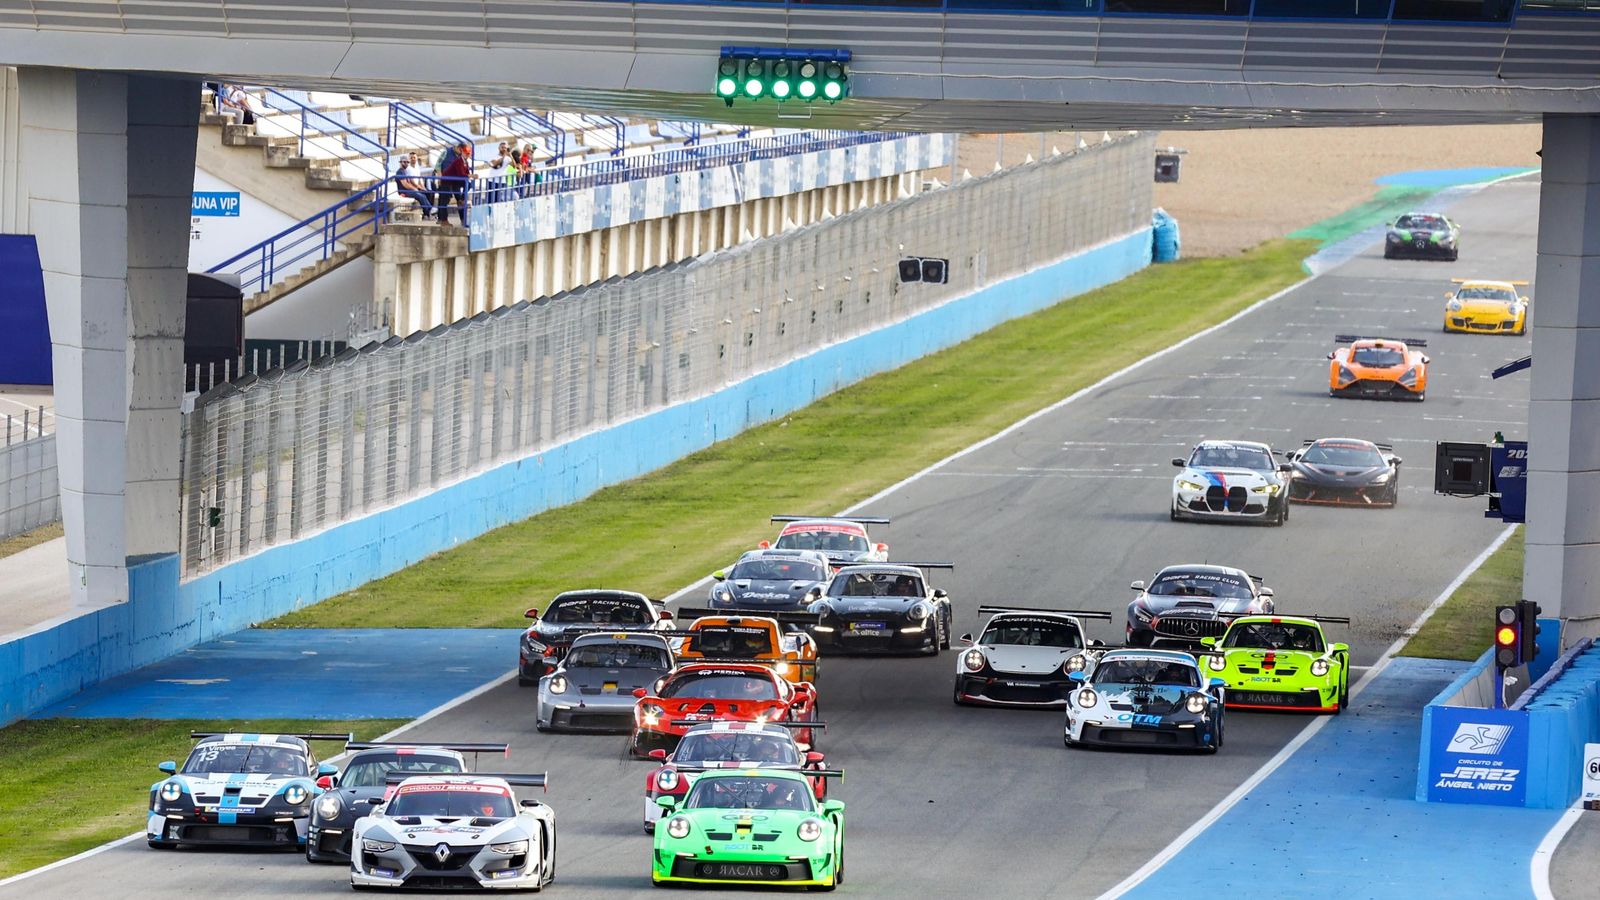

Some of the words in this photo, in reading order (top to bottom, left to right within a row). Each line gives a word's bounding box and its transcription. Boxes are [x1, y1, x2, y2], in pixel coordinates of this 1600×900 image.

[220, 197, 237, 209] VIP
[1117, 713, 1162, 724] OTM
[198, 751, 219, 762] 13
[1440, 766, 1520, 781] JEREZ
[1435, 778, 1475, 789] ÁNGEL
[1476, 782, 1513, 791] NIETO
